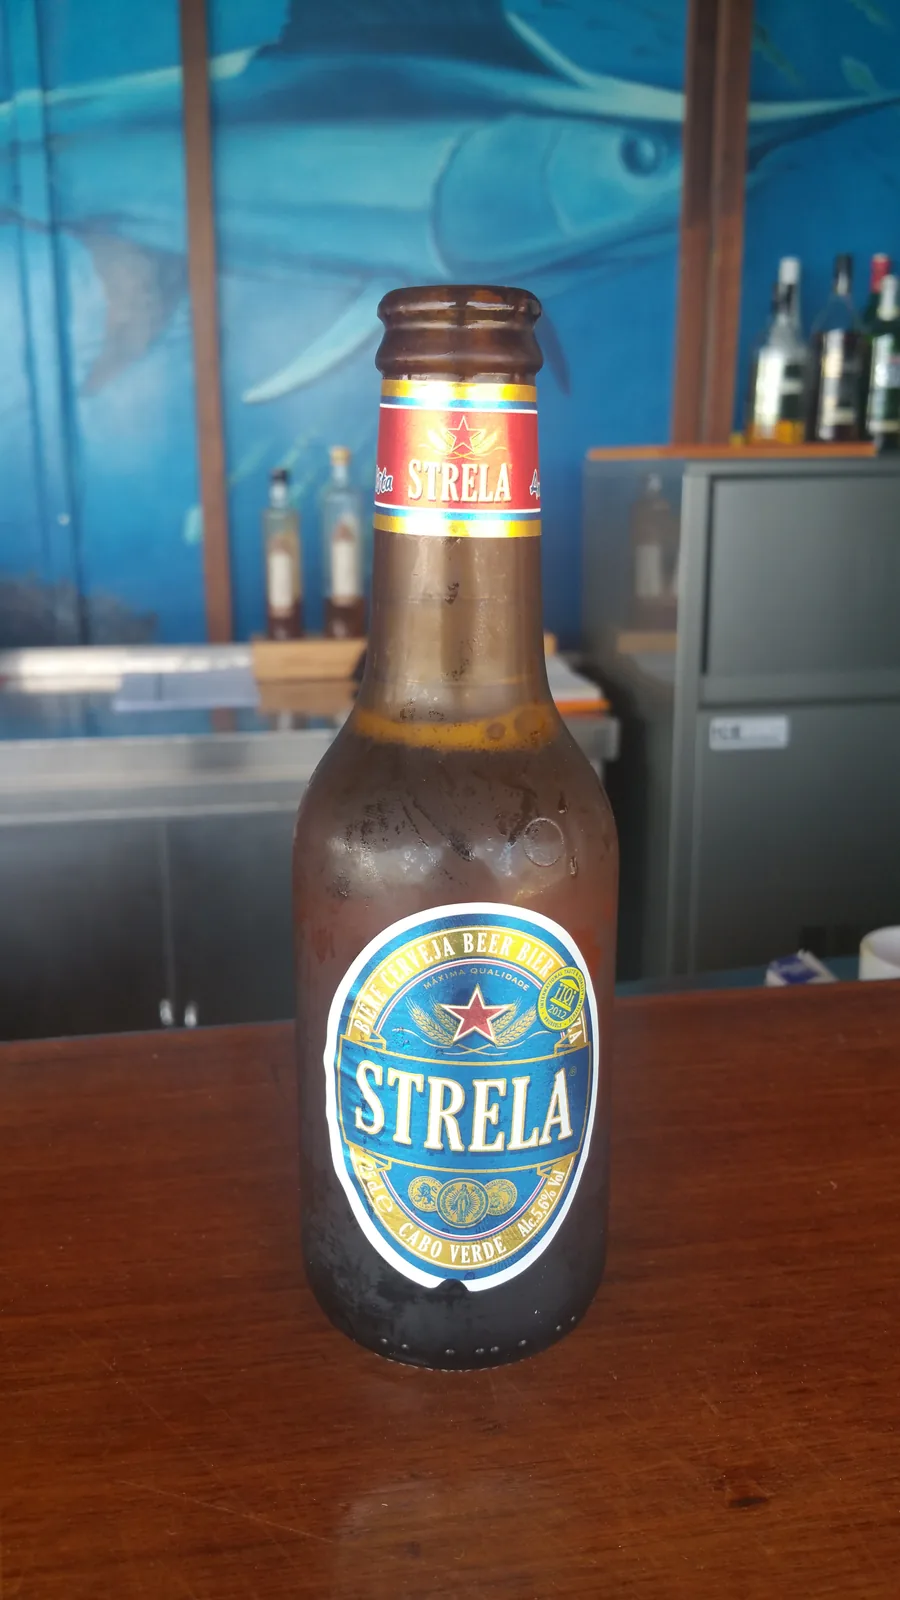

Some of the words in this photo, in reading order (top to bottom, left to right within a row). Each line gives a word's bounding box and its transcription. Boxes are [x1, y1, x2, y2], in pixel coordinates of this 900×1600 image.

[408, 459, 512, 502] STRELA
[379, 936, 456, 989] CERVEJA
[462, 932, 513, 957] BEER
[515, 941, 554, 979] BIER
[423, 969, 466, 990] MÁXIMA
[469, 967, 531, 992] QUALIDADE
[547, 1004, 567, 1020] 2012
[355, 1060, 574, 1153] STRELA
[547, 1170, 566, 1187] Vol
[398, 1222, 443, 1258] CABO
[450, 1236, 507, 1264] VERDE
